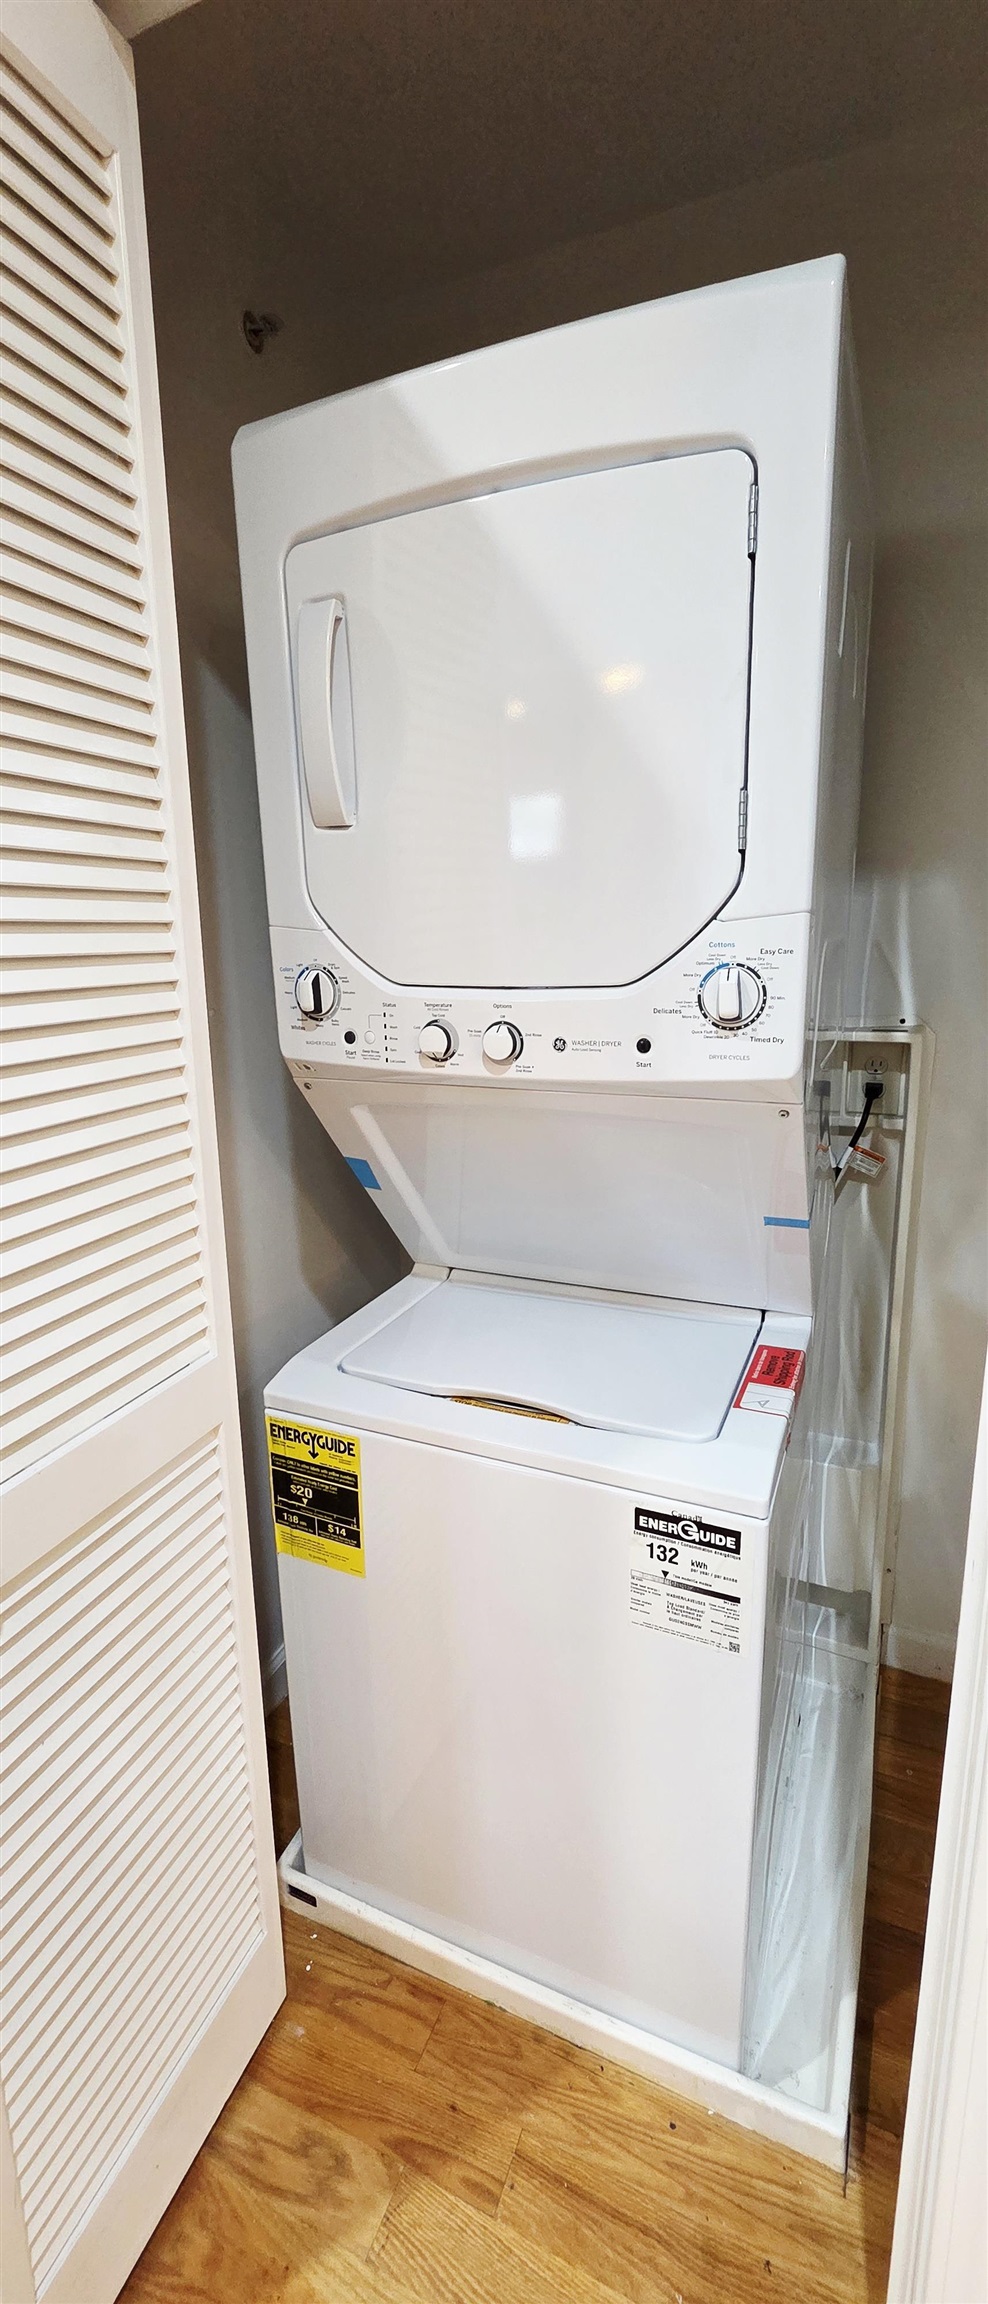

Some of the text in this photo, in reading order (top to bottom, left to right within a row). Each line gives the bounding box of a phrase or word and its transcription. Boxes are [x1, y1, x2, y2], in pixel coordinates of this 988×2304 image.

[760, 948, 776, 956] Easy
[571, 1039, 598, 1047] WASHER
[772, 1036, 785, 1045] Dry
[269, 1422, 356, 1458] ENERGYGUIDE
[289, 1484, 313, 1499] $20
[282, 1512, 299, 1524] 138
[327, 1524, 347, 1537] $14
[638, 1514, 737, 1550] ENERGUIDE
[633, 1530, 649, 1539] Energy
[648, 1534, 677, 1545] consumption
[680, 1541, 714, 1553] Consommation
[645, 1542, 680, 1566] 132
[690, 1559, 708, 1570] kWh
